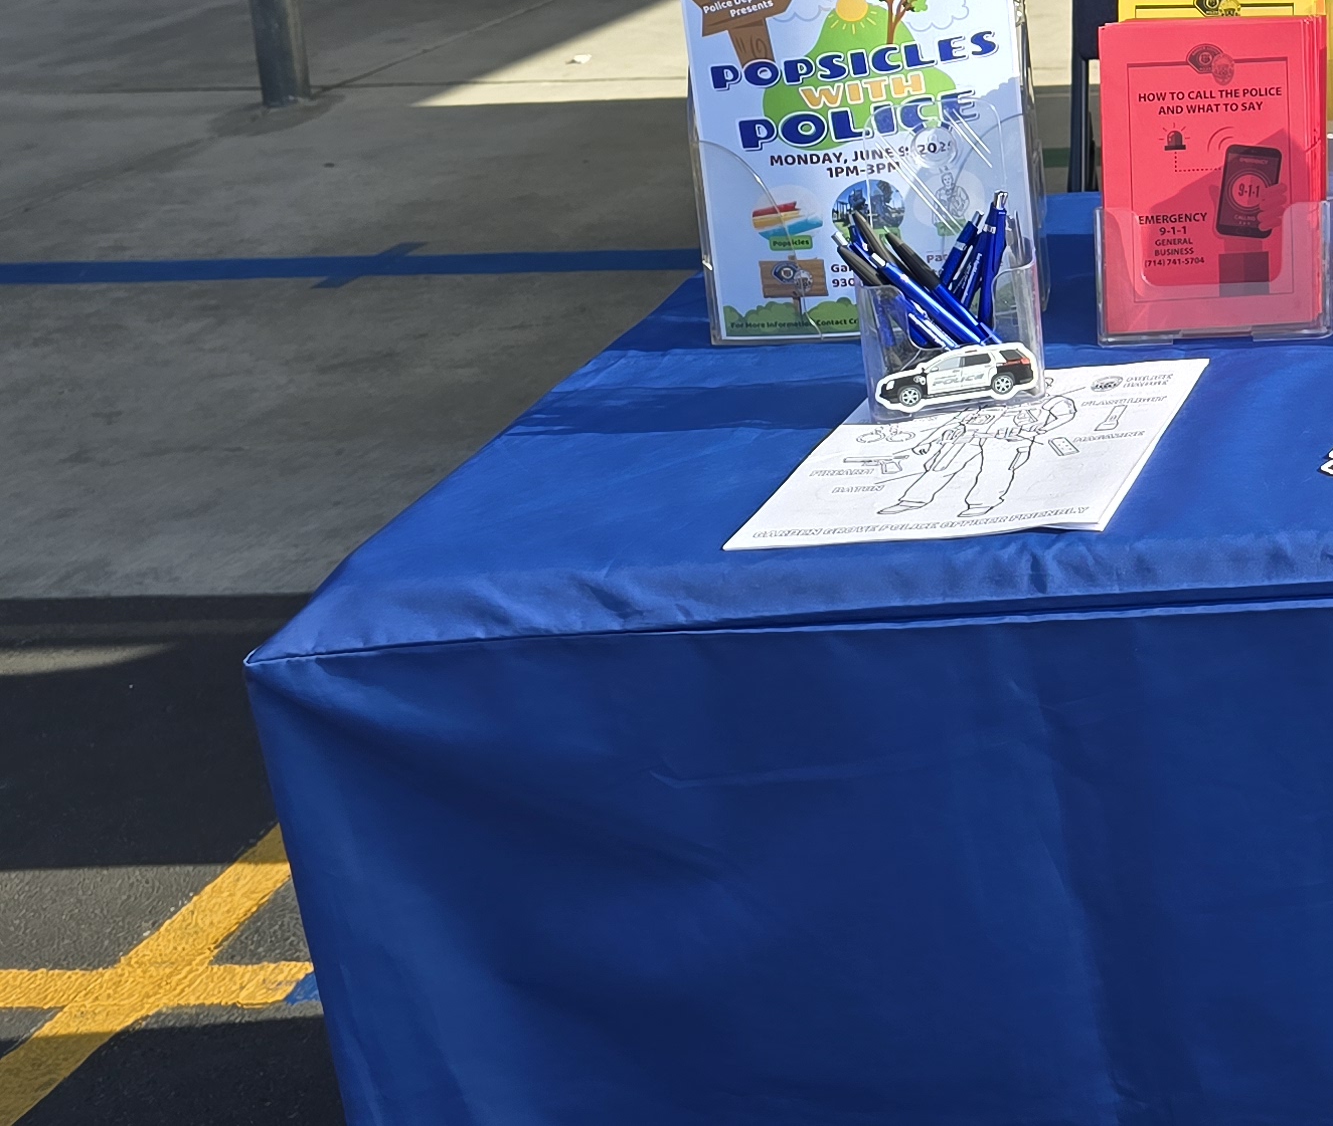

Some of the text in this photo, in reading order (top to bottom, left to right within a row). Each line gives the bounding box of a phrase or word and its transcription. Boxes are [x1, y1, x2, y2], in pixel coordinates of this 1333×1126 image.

[702, 0, 733, 14] Police
[729, 0, 774, 18] Presents
[710, 30, 999, 92] POPSICLES
[799, 72, 926, 110] WITH
[1138, 87, 1282, 102] HOW TO CALL THE POLICE
[1159, 101, 1263, 115] AND WHAT TO SAY
[738, 89, 980, 152] POLICE
[770, 151, 848, 166] MONDAY,
[852, 147, 894, 162] JUNE
[1238, 183, 1260, 198] 9-1-1
[1139, 212, 1208, 225] EMERGENCY
[1159, 226, 1187, 235] 9-1-1
[772, 238, 810, 247] Popsicles
[1155, 238, 1193, 247] GENERAL
[1154, 247, 1194, 257] BUSINESS
[1144, 257, 1205, 267] (714) 741-5704
[932, 374, 984, 386] POLICE
[752, 506, 1090, 539] GARDEN GROVE POLICE OFFICER FRIENDLY
